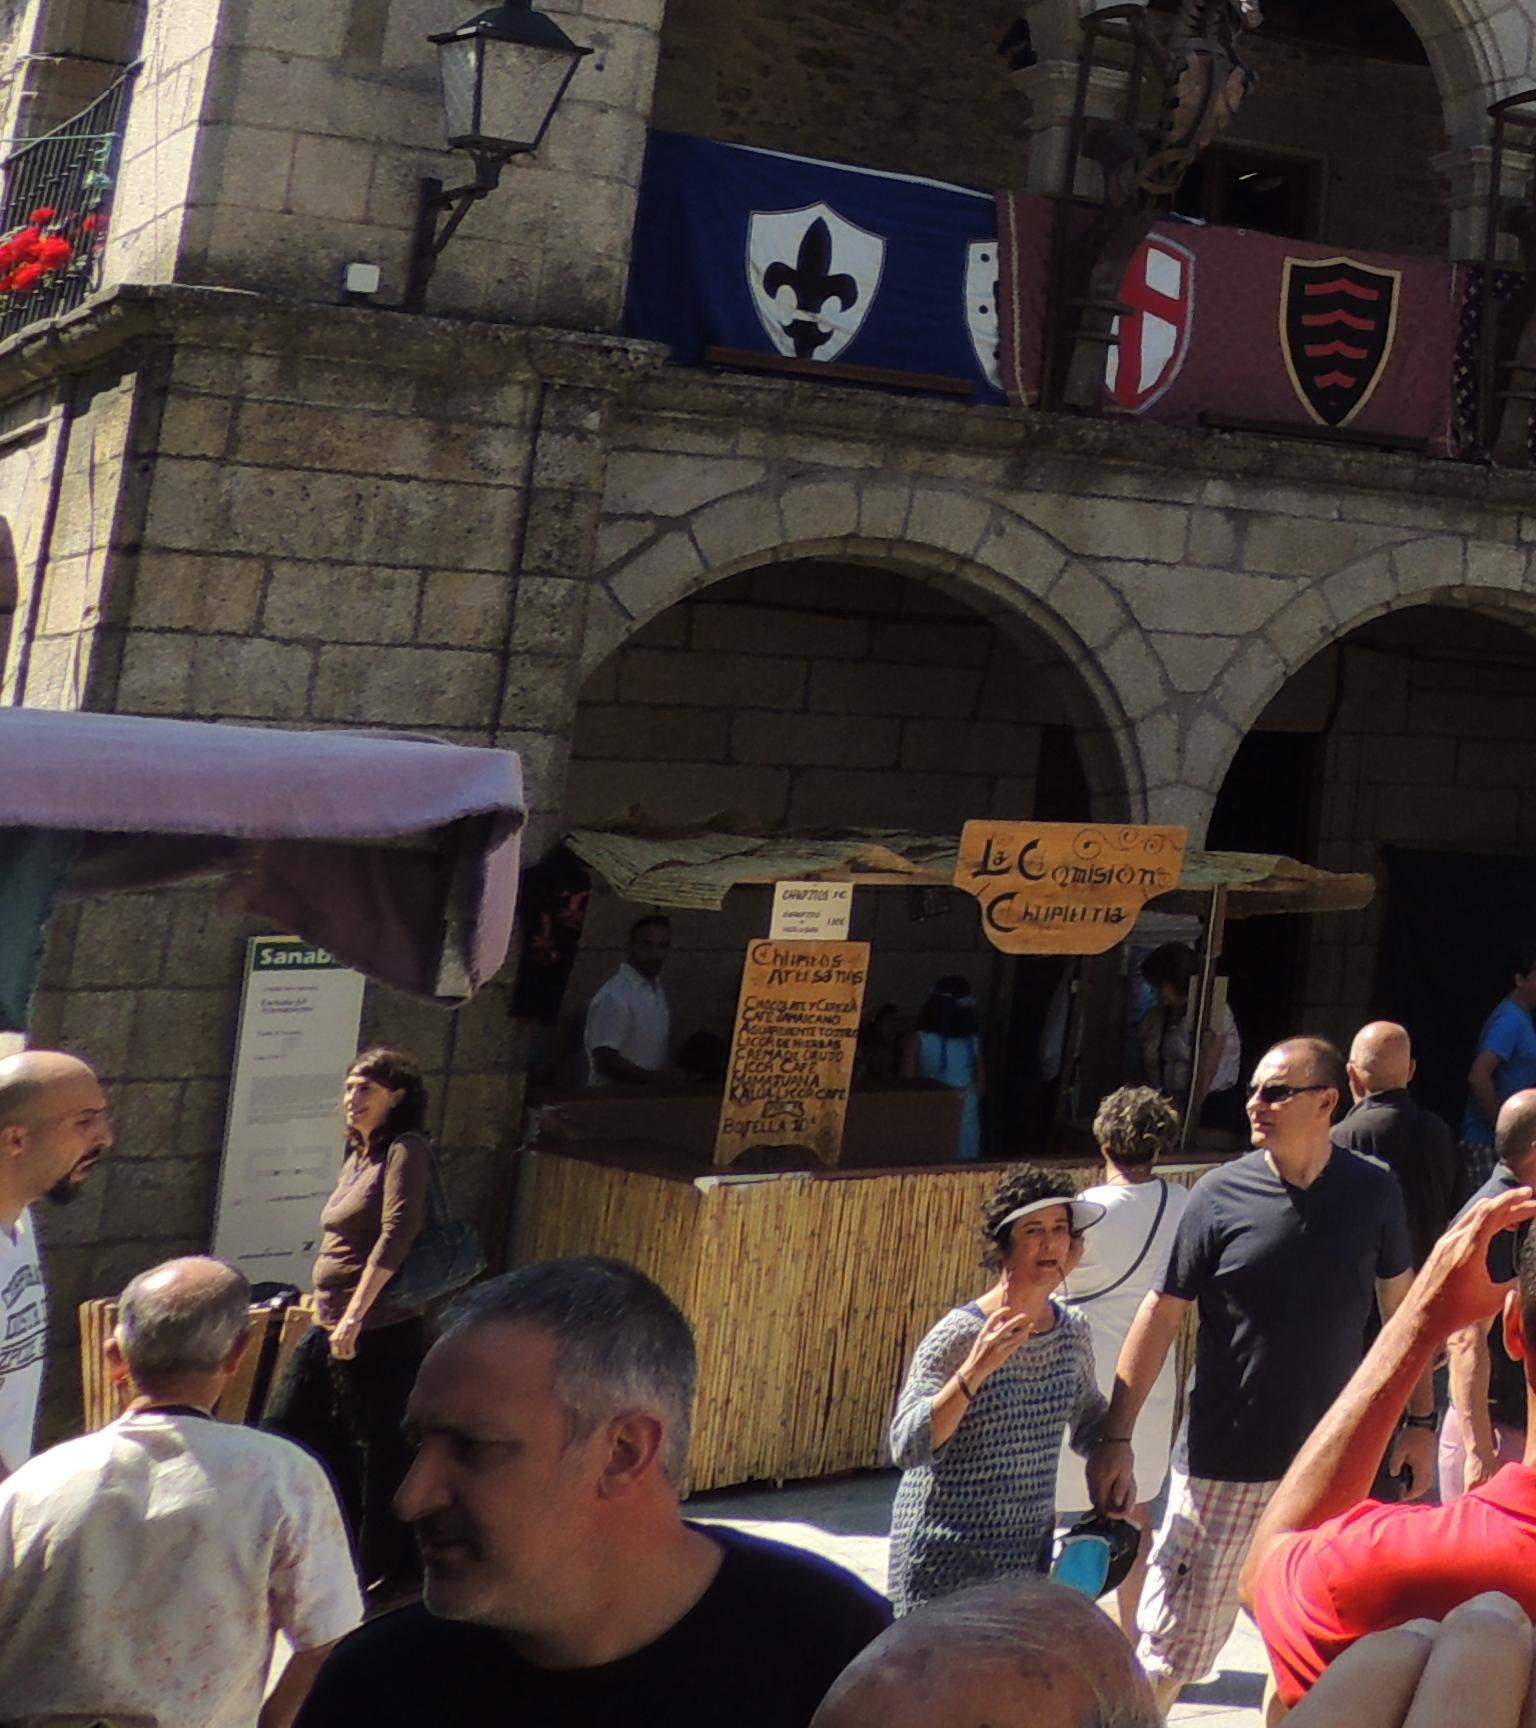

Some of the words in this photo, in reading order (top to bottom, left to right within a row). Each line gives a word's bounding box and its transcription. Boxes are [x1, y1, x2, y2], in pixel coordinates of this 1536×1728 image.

[971, 837, 1012, 878] La
[736, 1032, 774, 1048] LICOR
[776, 1038, 789, 1048] DE
[733, 1059, 773, 1073] LICOR
[724, 1118, 786, 1138] BOTELLA
